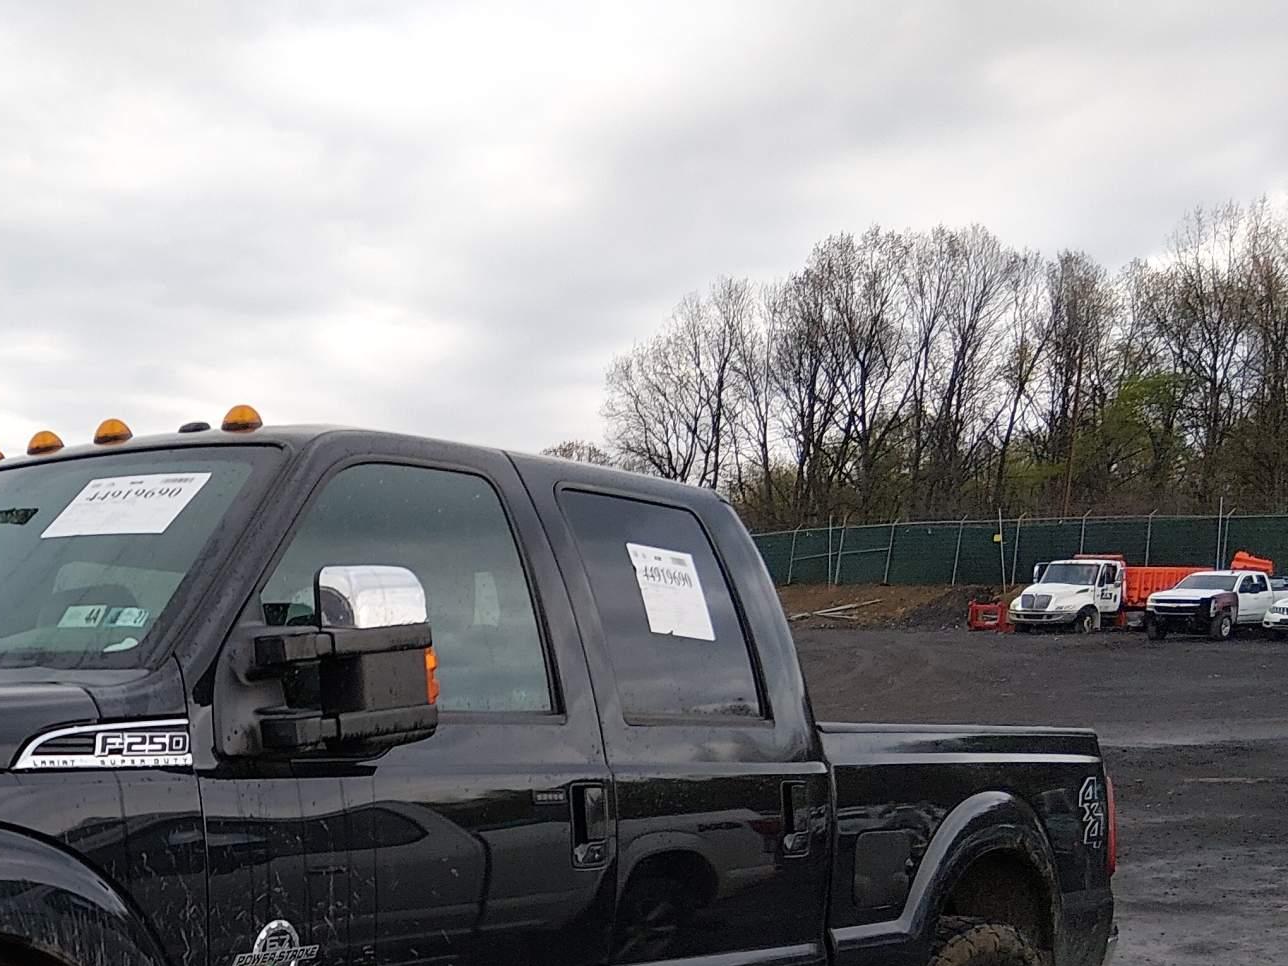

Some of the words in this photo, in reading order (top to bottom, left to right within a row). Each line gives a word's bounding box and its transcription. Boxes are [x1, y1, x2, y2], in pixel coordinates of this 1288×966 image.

[85, 486, 184, 502] 44919690
[643, 566, 693, 588] 44919690
[95, 731, 190, 757] F-250
[32, 758, 76, 767] LARIAT
[100, 758, 147, 767] SUPER
[153, 757, 191, 766] DUTY
[276, 945, 319, 962] STROKE
